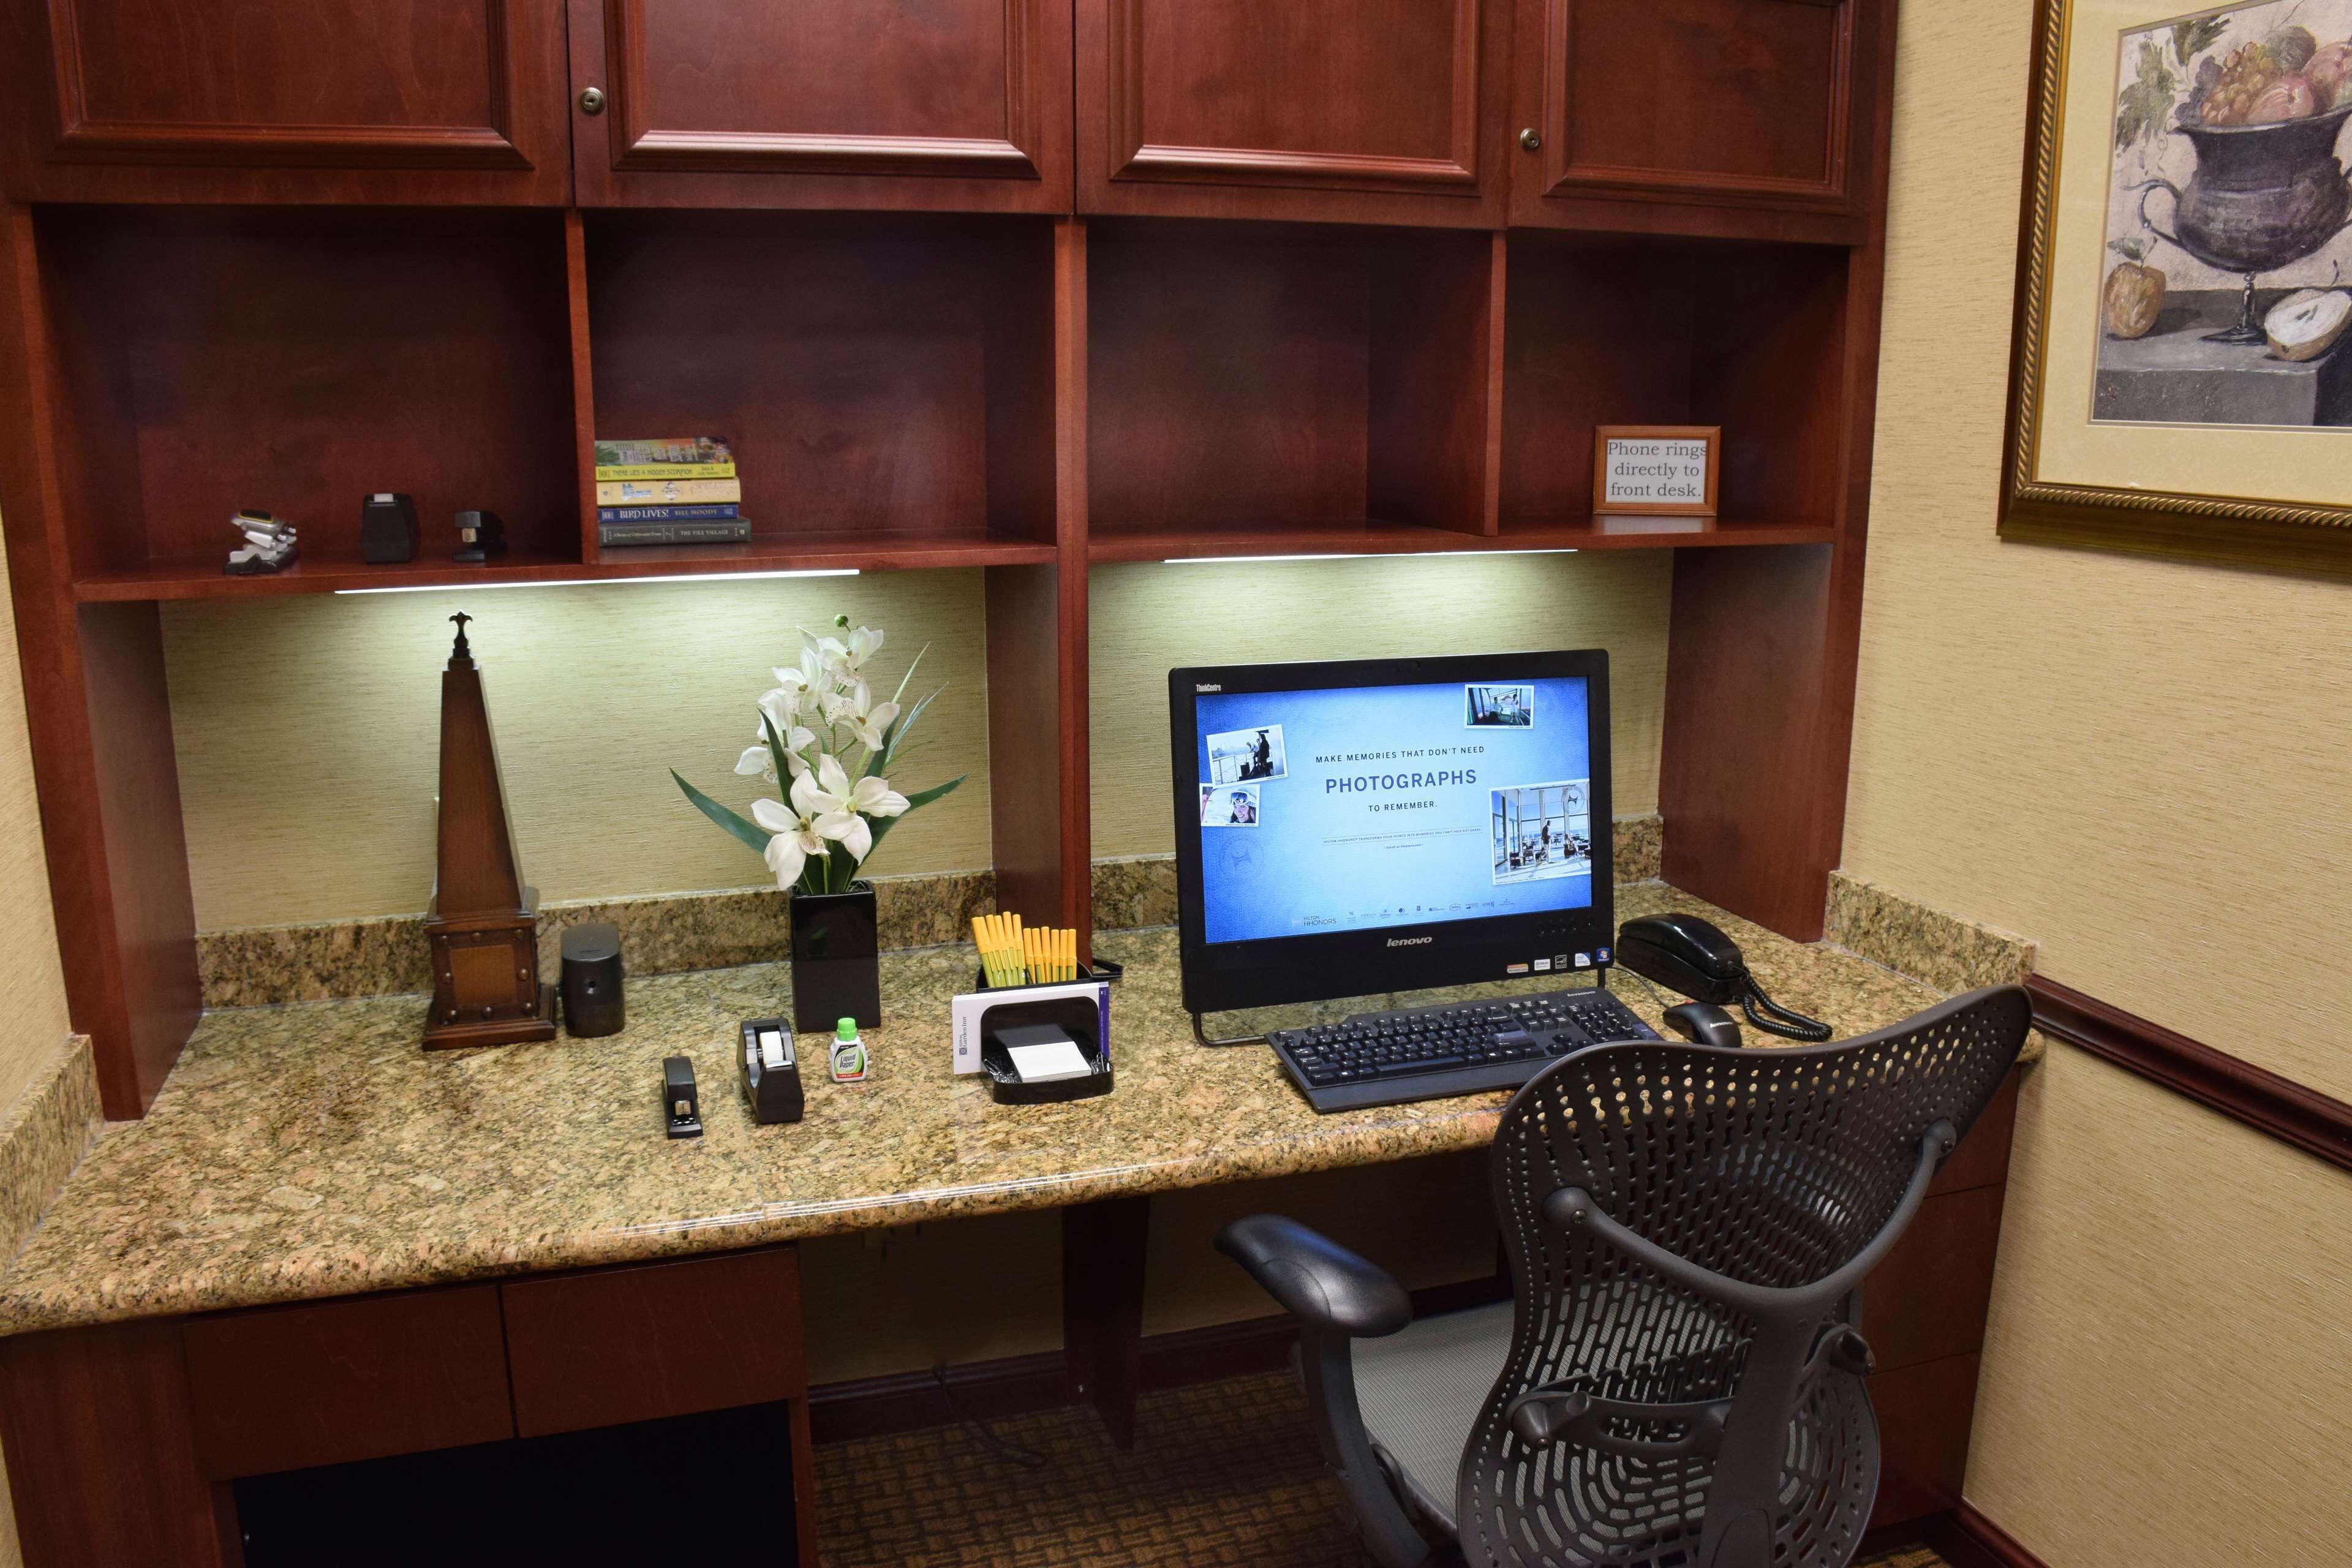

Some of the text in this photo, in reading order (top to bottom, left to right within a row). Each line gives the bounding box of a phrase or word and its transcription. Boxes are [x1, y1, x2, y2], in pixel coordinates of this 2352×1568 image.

[1608, 442, 1707, 459] Phone rings
[1615, 462, 1699, 480] directly to
[1611, 482, 1701, 497] front desk.
[620, 510, 641, 519] BIRD
[643, 509, 669, 518] LIVES!
[1196, 684, 1221, 692] ThinkCentre
[1316, 755, 1343, 763] MAKE
[1347, 752, 1397, 761] MEMORIES
[1401, 750, 1425, 758] THAT
[1428, 747, 1457, 756] DON'T
[1325, 769, 1477, 794] PHOTOGRAPHS
[1384, 801, 1438, 811] REMEMBER.
[1303, 918, 1337, 927] HHONORS
[1387, 937, 1432, 947] lenovo
[841, 1054, 856, 1062] Liquid
